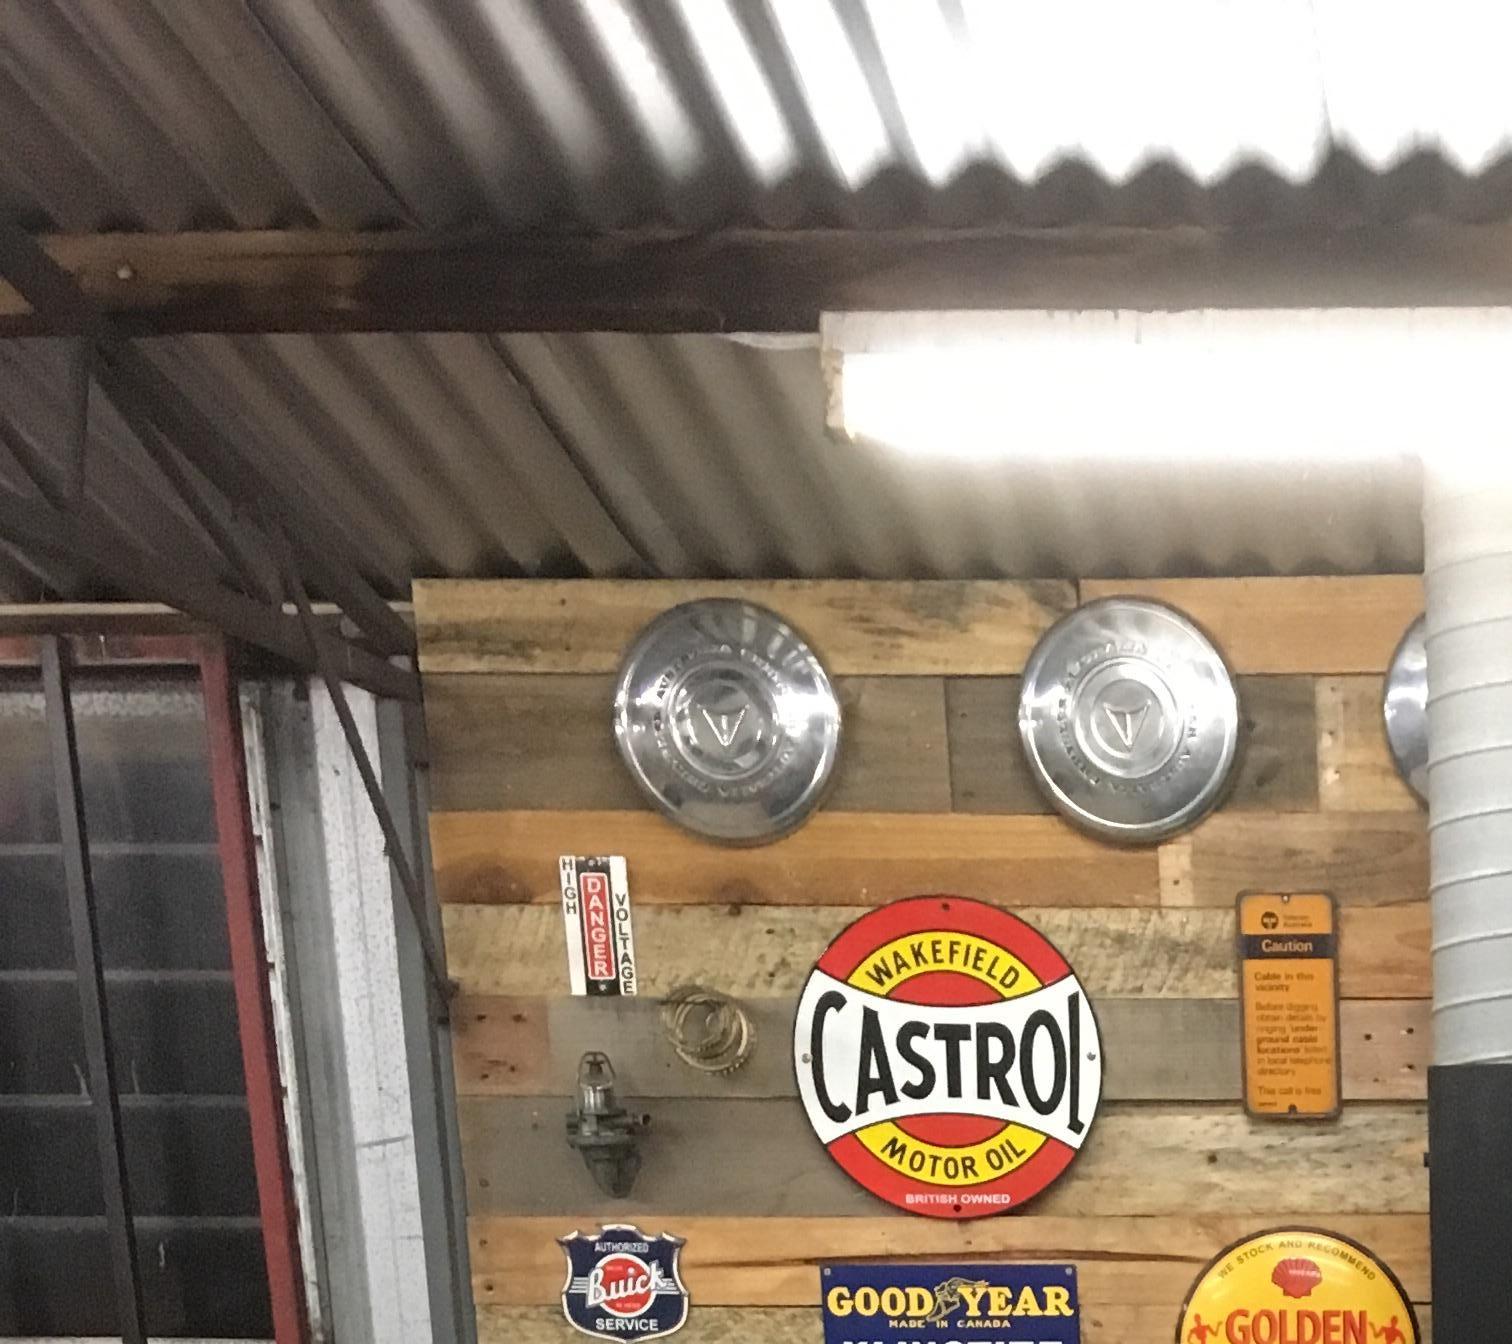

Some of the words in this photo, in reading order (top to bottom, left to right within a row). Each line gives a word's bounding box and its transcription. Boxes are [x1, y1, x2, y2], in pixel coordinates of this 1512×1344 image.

[562, 858, 577, 915] HIGH
[587, 877, 608, 976] DANGER
[615, 893, 634, 994] VOLTAGE
[1261, 939, 1313, 952] Caution
[865, 939, 1020, 989] WAKEFIELD
[811, 990, 1085, 1135] CASTROL
[880, 1136, 979, 1179] MOTOR
[986, 1139, 1026, 1171] OIL
[905, 1193, 957, 1204] BRITISH
[961, 1193, 1011, 1204] OWNED
[594, 1242, 649, 1253] AUTHORIZED
[1218, 1264, 1234, 1280] WE
[1236, 1243, 1273, 1265] STOCK
[1278, 1240, 1303, 1249] AND
[1308, 1241, 1376, 1281] RECOMMEND
[586, 1260, 667, 1307] Buick
[827, 1286, 934, 1317] GOOD
[957, 1285, 1074, 1317] YEAR
[595, 1318, 659, 1331] SERVICE
[889, 1319, 925, 1328] MADE
[936, 1319, 948, 1328] IN
[957, 1319, 1011, 1328] CANADA
